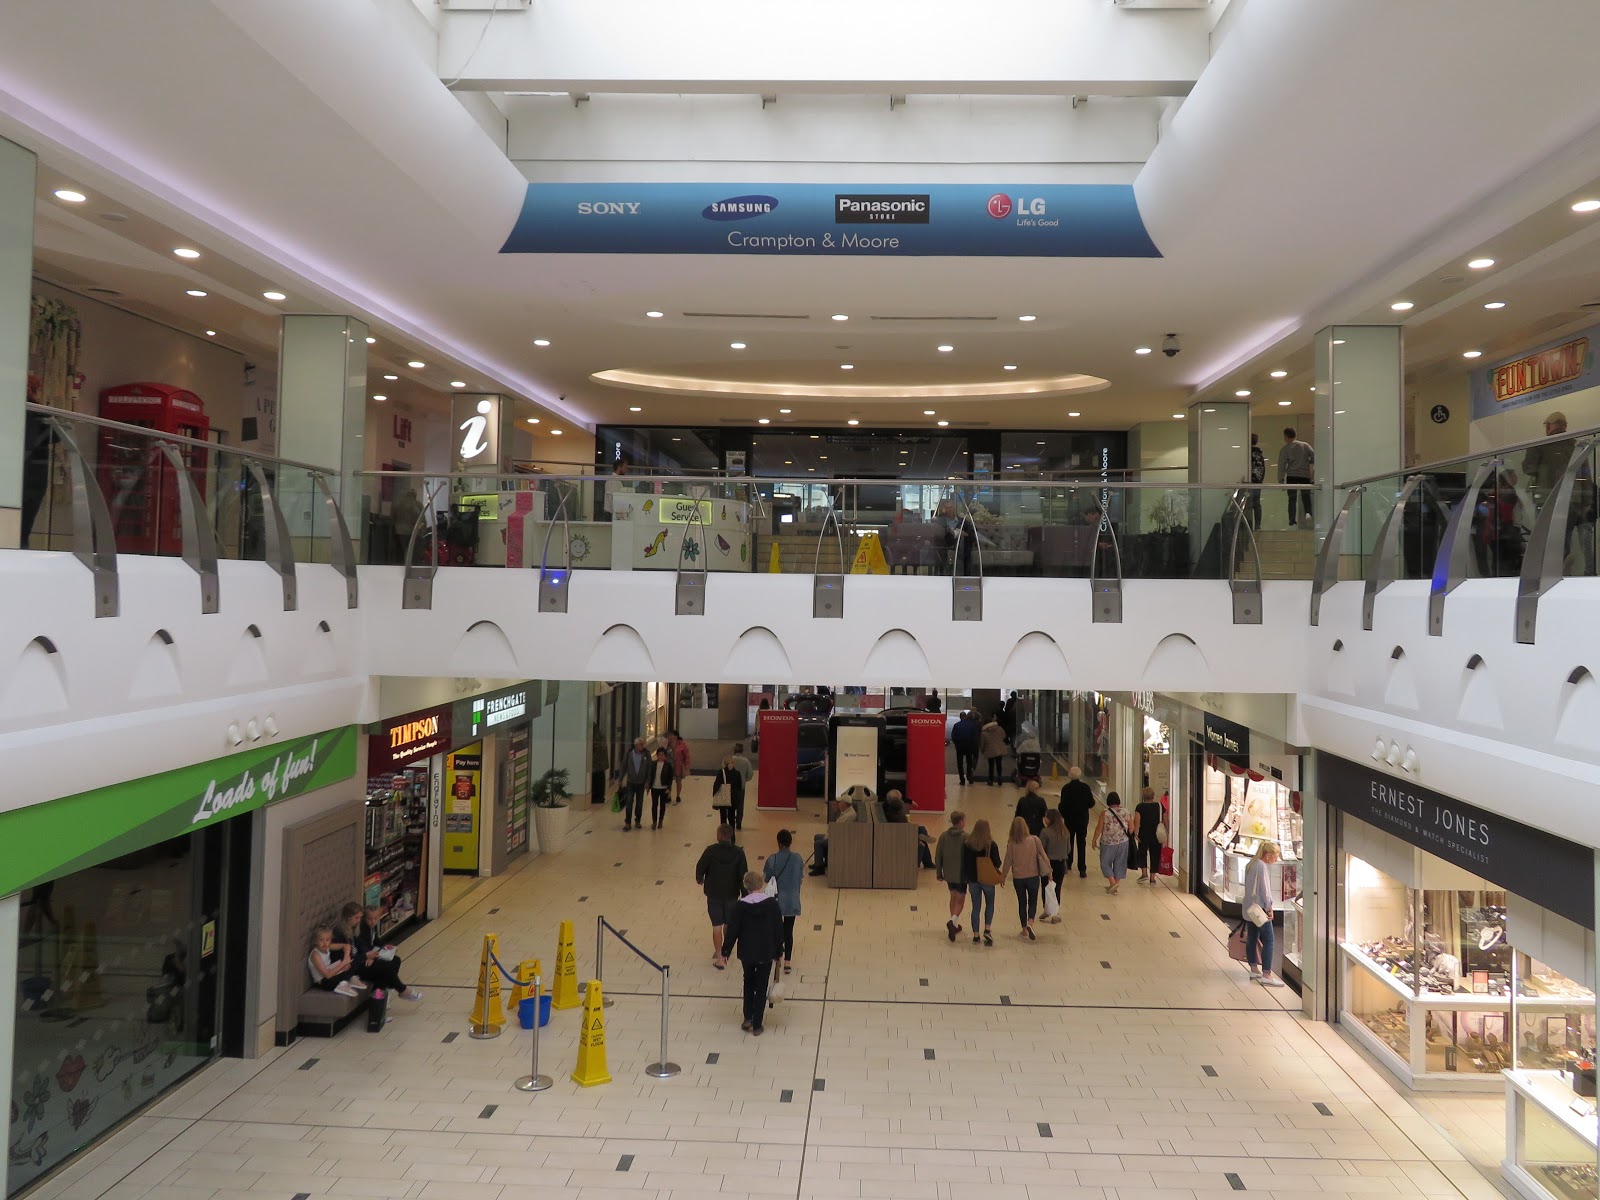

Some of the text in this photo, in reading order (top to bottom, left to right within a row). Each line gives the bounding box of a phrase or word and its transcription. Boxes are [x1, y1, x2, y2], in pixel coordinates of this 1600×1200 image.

[577, 202, 641, 215] SONY
[711, 202, 772, 213] SAMSUNG
[838, 198, 926, 213] Panasonic
[1016, 198, 1046, 215] LG
[1016, 218, 1059, 227] Life's Good
[727, 231, 900, 250] Crampton & Moore
[487, 691, 526, 715] FRENCHGATE
[390, 715, 439, 748] TIMPSON
[192, 739, 317, 824] Loads of fun!
[1371, 780, 1489, 846] ERNEST JONES
[1371, 806, 1382, 816] THE
[1384, 811, 1412, 830] DIAMOND
[1423, 828, 1444, 845] WATCH
[1447, 840, 1489, 865] SPECIALIST
